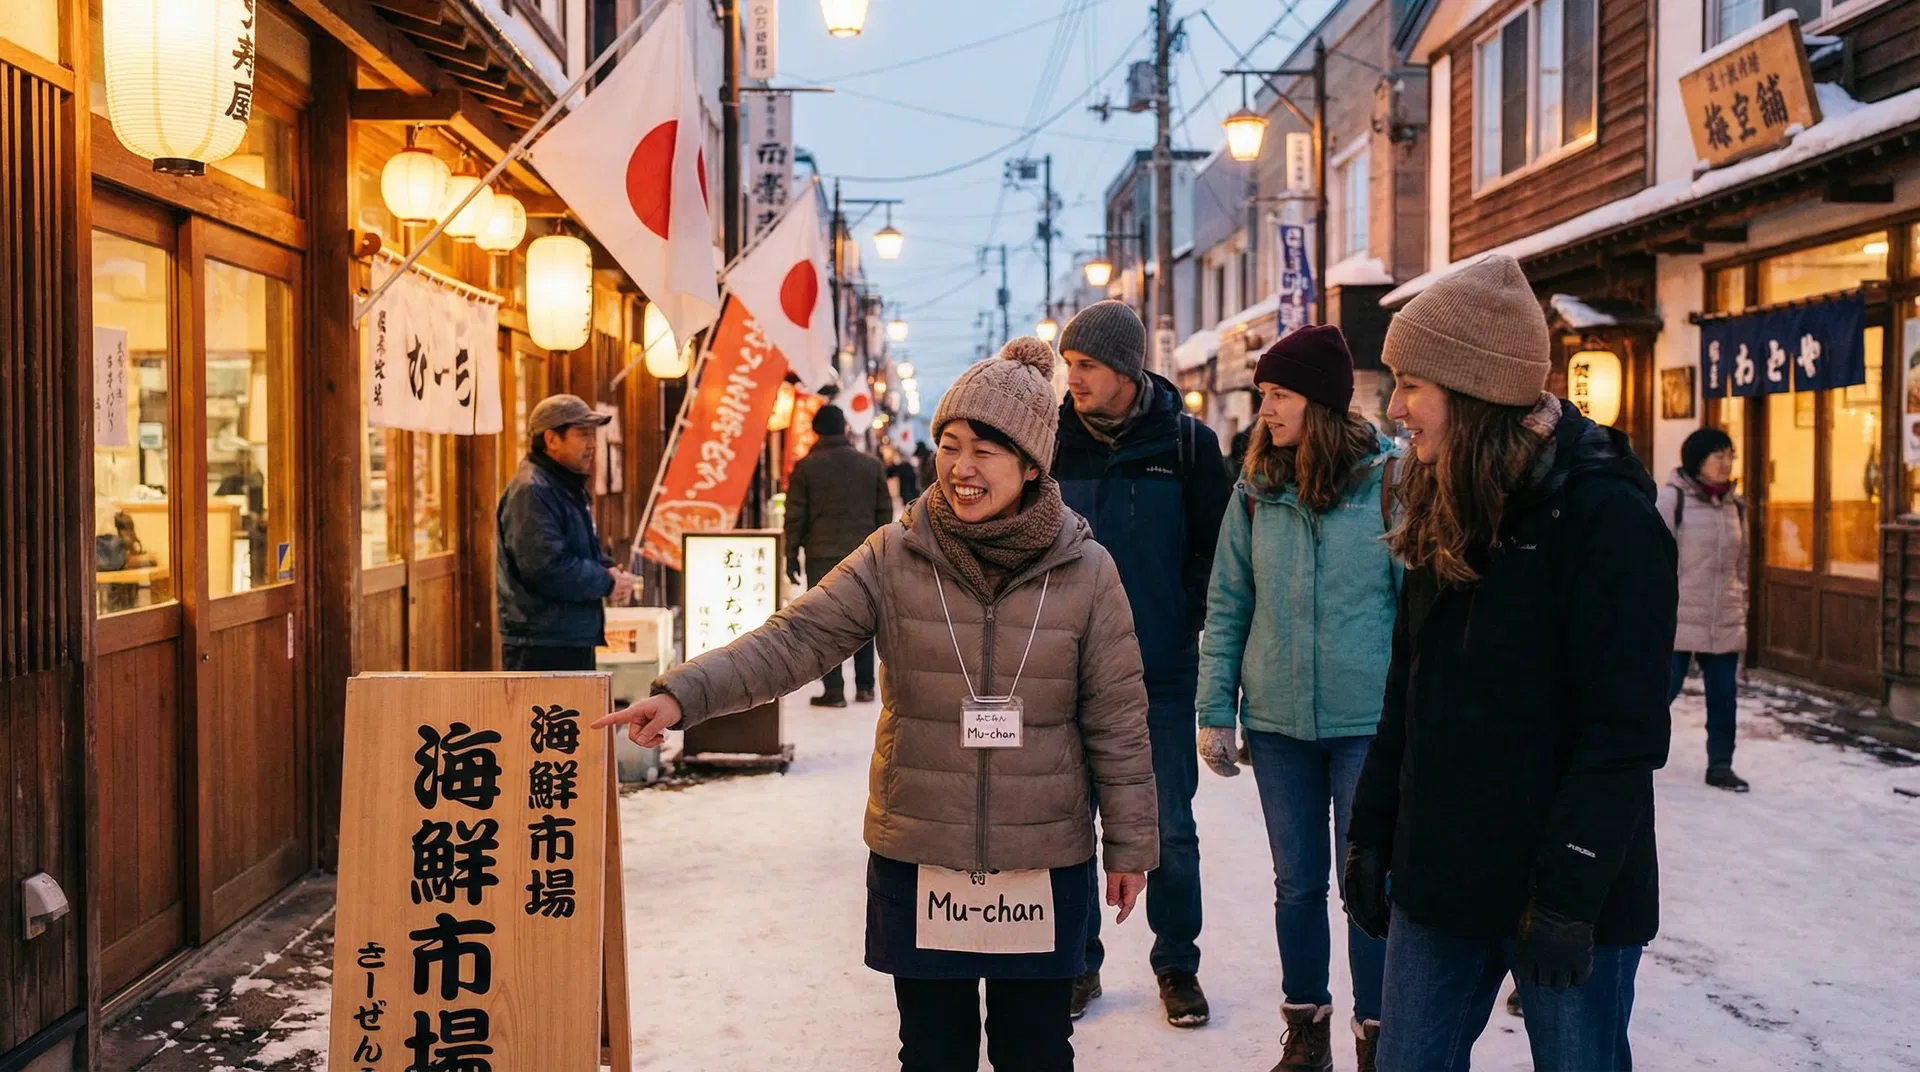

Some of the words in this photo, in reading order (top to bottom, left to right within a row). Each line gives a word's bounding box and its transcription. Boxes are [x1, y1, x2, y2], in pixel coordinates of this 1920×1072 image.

[967, 727, 1016, 739] Mu-chan
[525, 704, 580, 918] 海鮮市場
[403, 721, 503, 1072] 海鮮市場
[928, 890, 1044, 923] Mu-chan
[352, 941, 387, 1072] さーぜん
